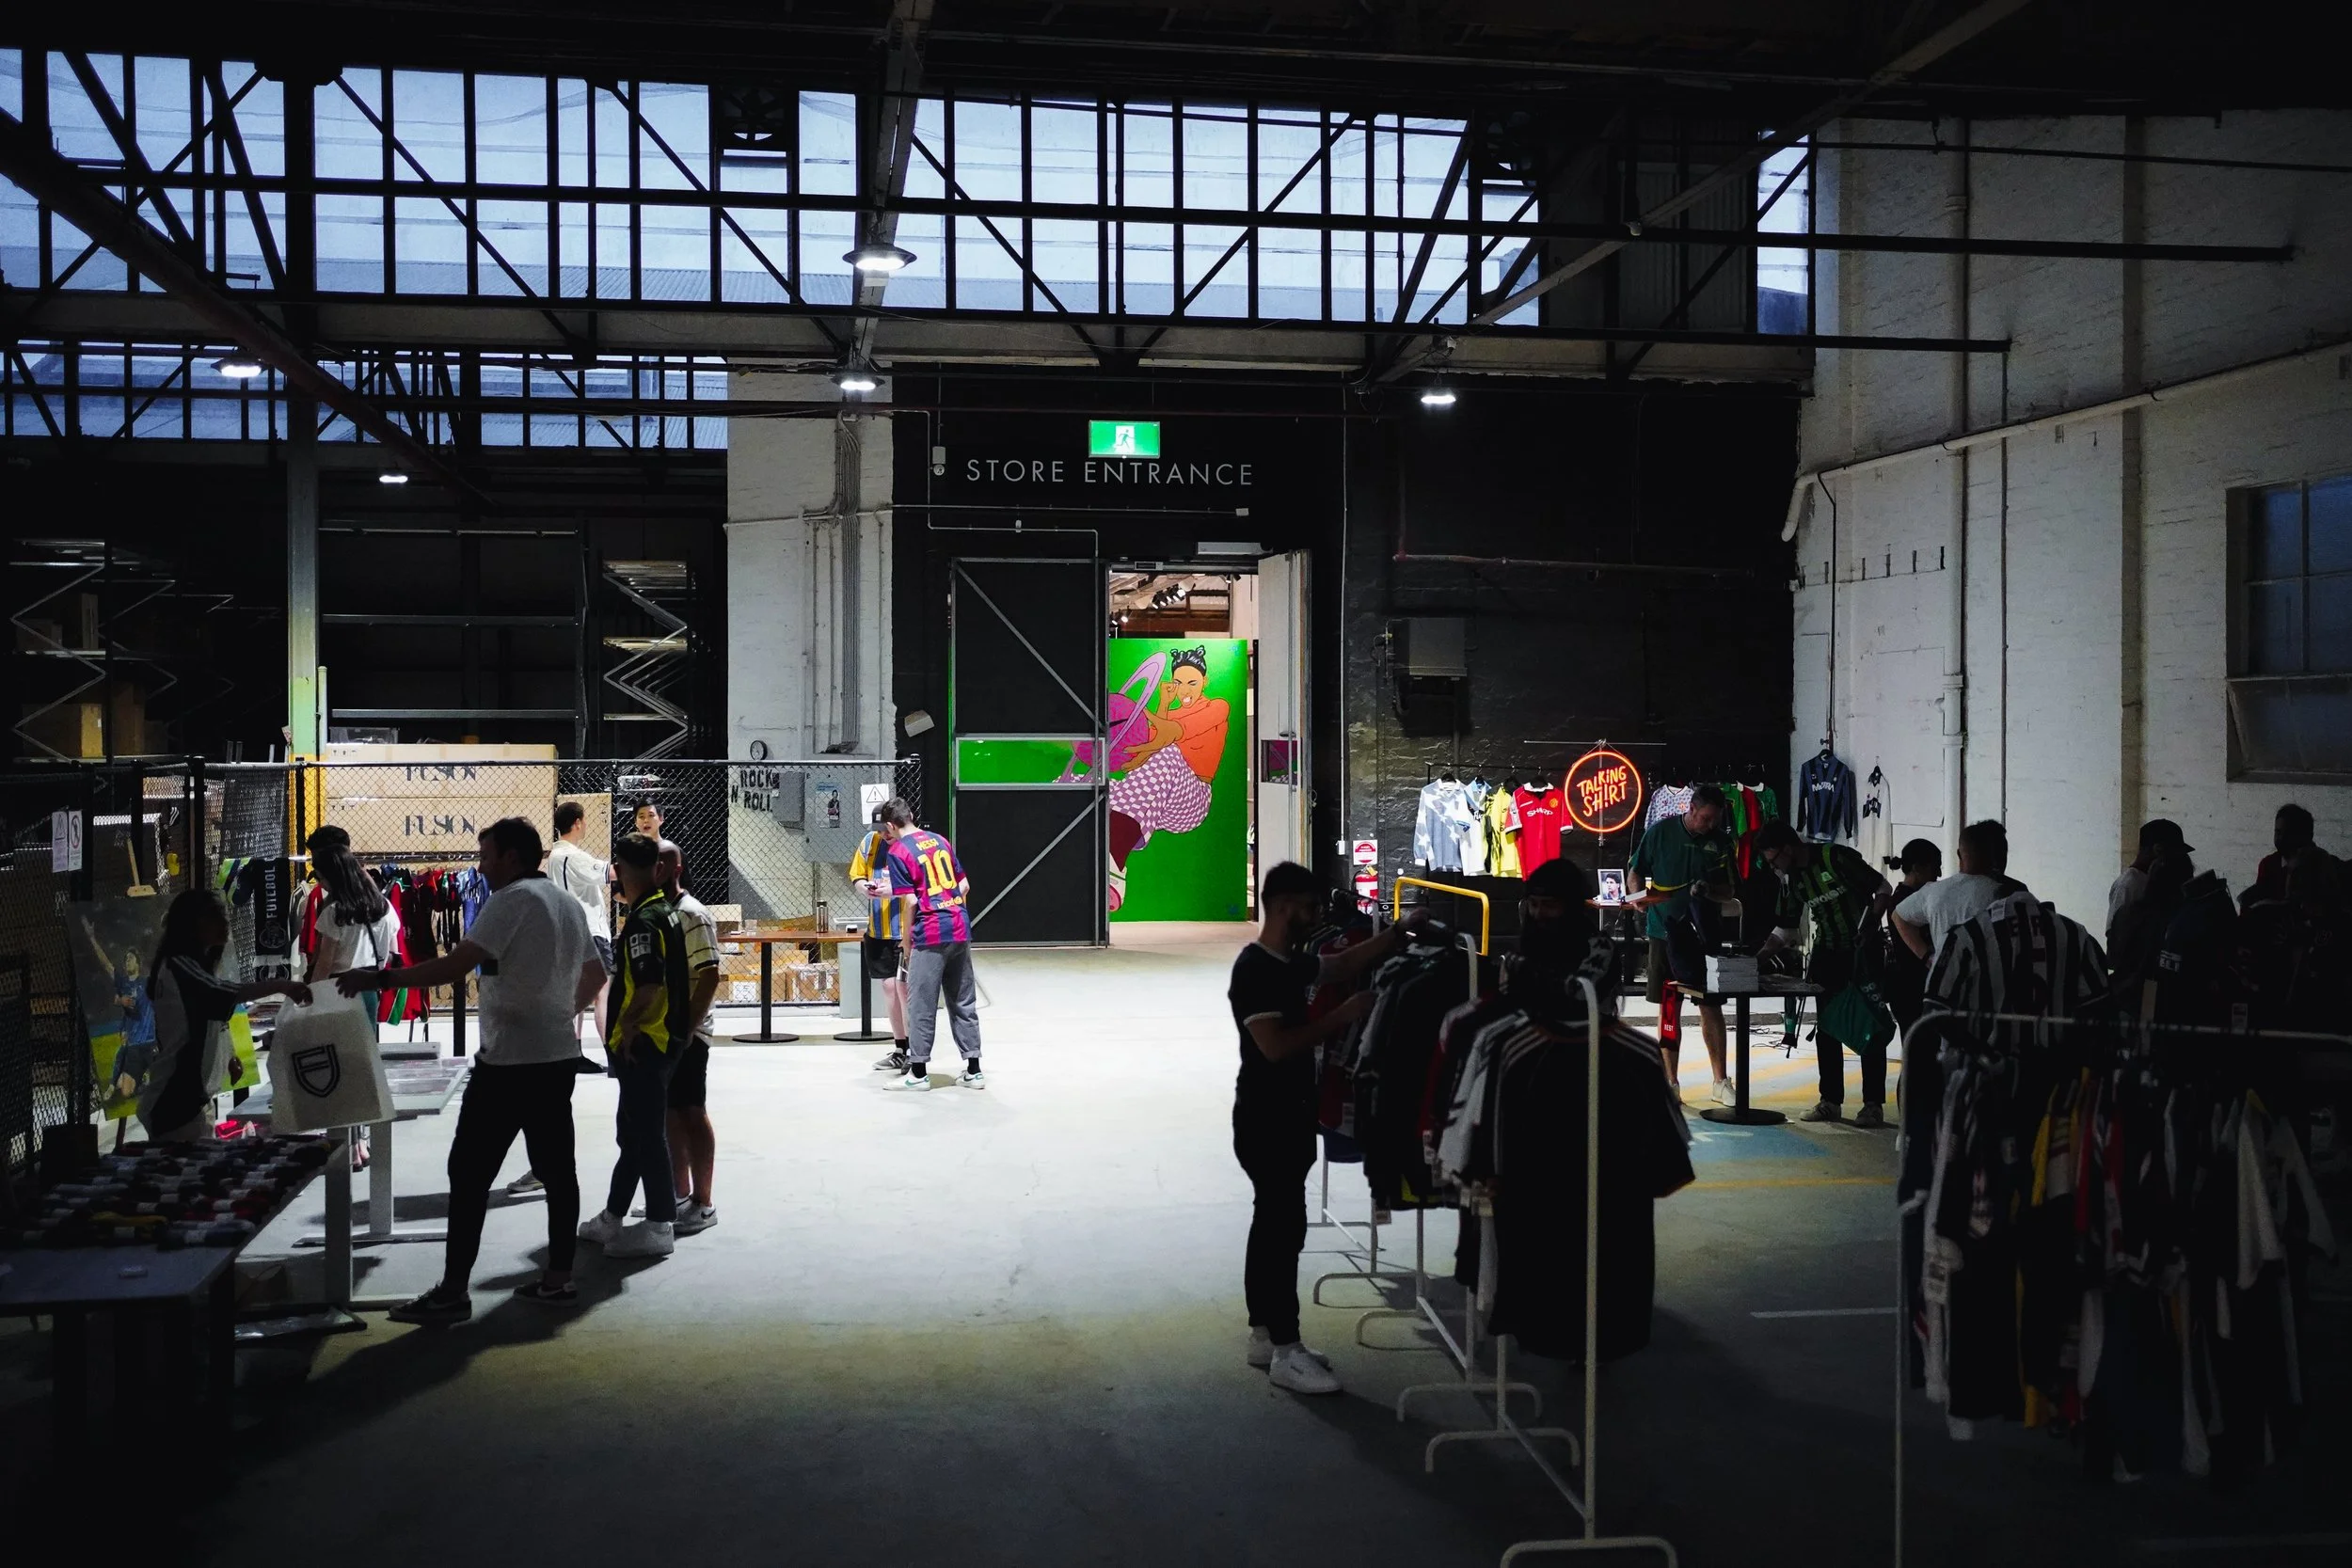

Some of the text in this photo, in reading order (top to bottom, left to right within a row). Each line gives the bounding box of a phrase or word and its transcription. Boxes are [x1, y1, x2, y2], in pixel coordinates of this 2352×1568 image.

[967, 459, 1253, 485] STORE ENTRANCE
[739, 768, 773, 788] ROCK
[730, 784, 773, 813] N ROLL
[1526, 807, 1553, 817] SHARP
[405, 815, 476, 837] FUSION
[916, 838, 939, 850] MESSI
[917, 849, 957, 895] 10
[264, 865, 278, 919] FUTEBOL
